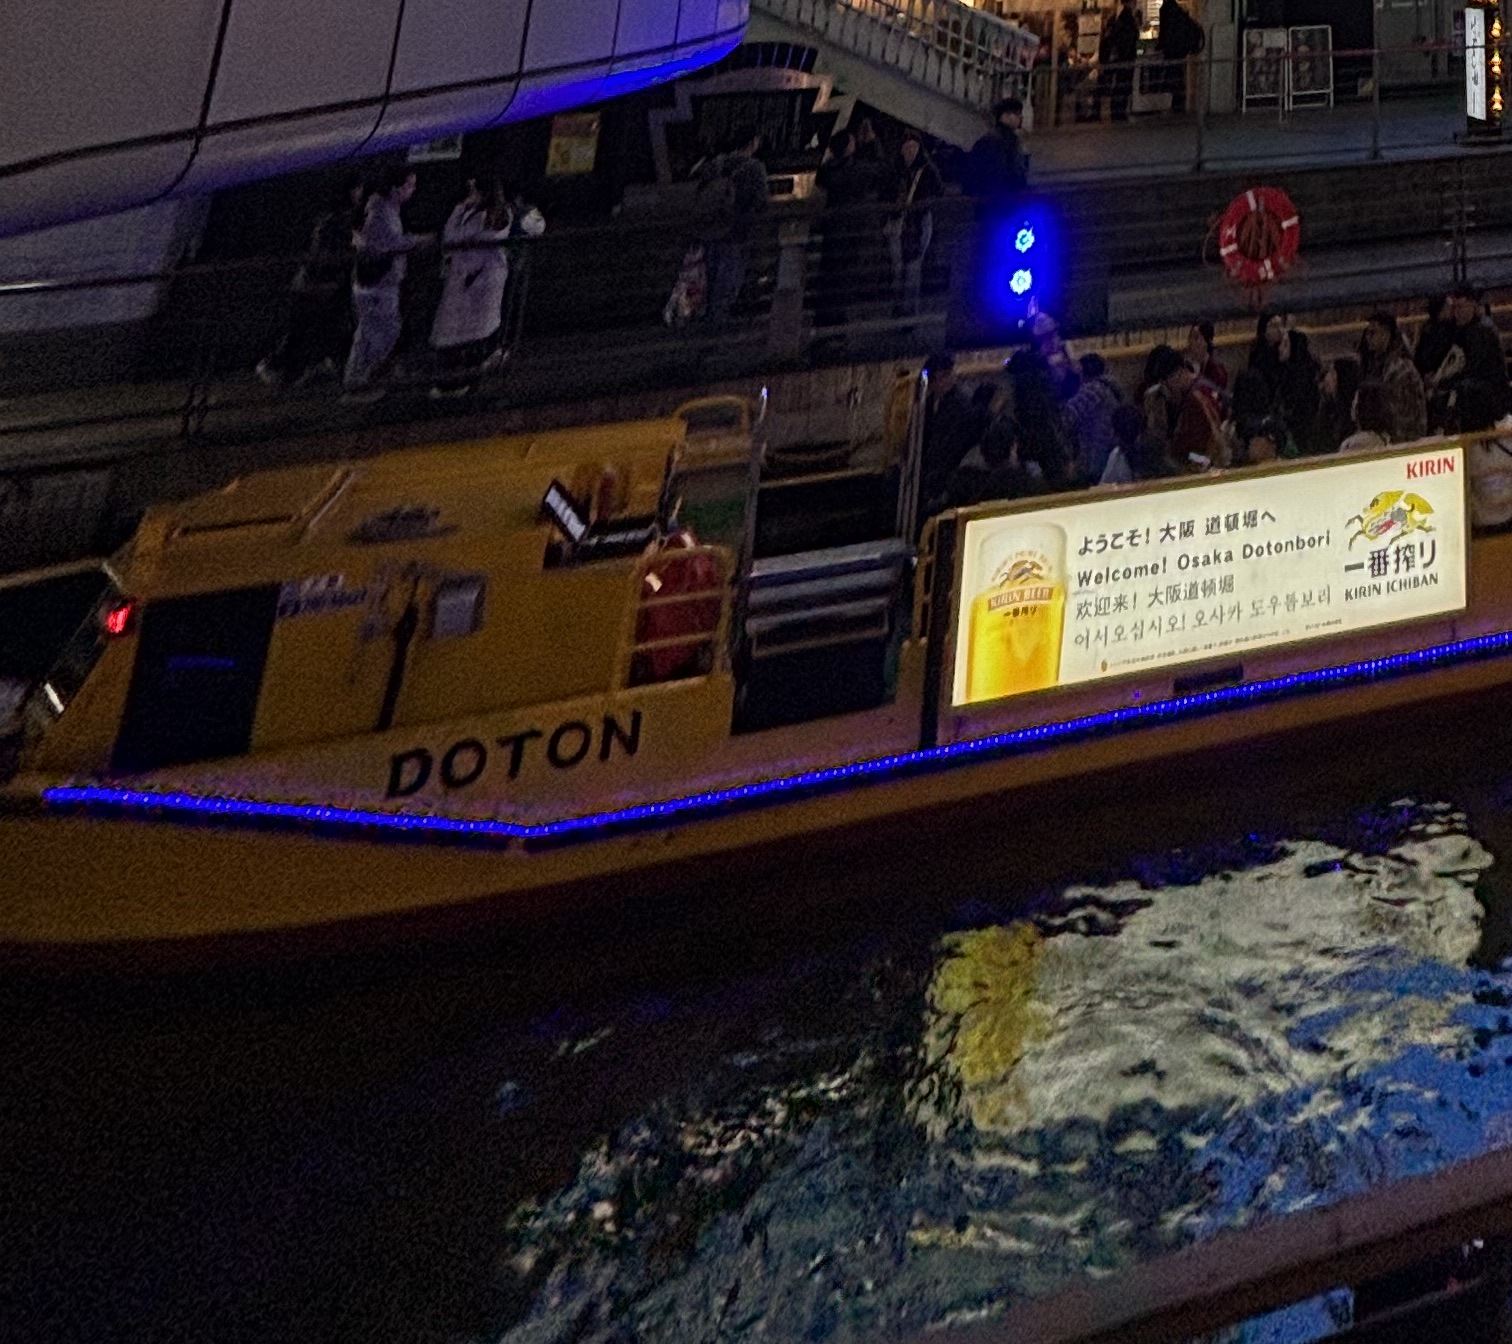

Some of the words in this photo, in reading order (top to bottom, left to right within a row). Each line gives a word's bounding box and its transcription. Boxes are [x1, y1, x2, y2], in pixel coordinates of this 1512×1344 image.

[1405, 456, 1456, 480] KIRIN
[1077, 525, 1151, 558] ようこそ!
[1158, 518, 1196, 544] 大阪
[1204, 508, 1277, 537] 道頓堀へ
[1076, 556, 1168, 588] Welcome!
[1176, 547, 1234, 571] Osaka
[1241, 528, 1332, 561] Dotonbori
[1343, 541, 1438, 581] 一番搾り
[1344, 582, 1383, 603] KIRIN
[1385, 571, 1440, 596] ICHIBAN
[1192, 600, 1244, 629] 오사카
[385, 710, 644, 801] DOTON
